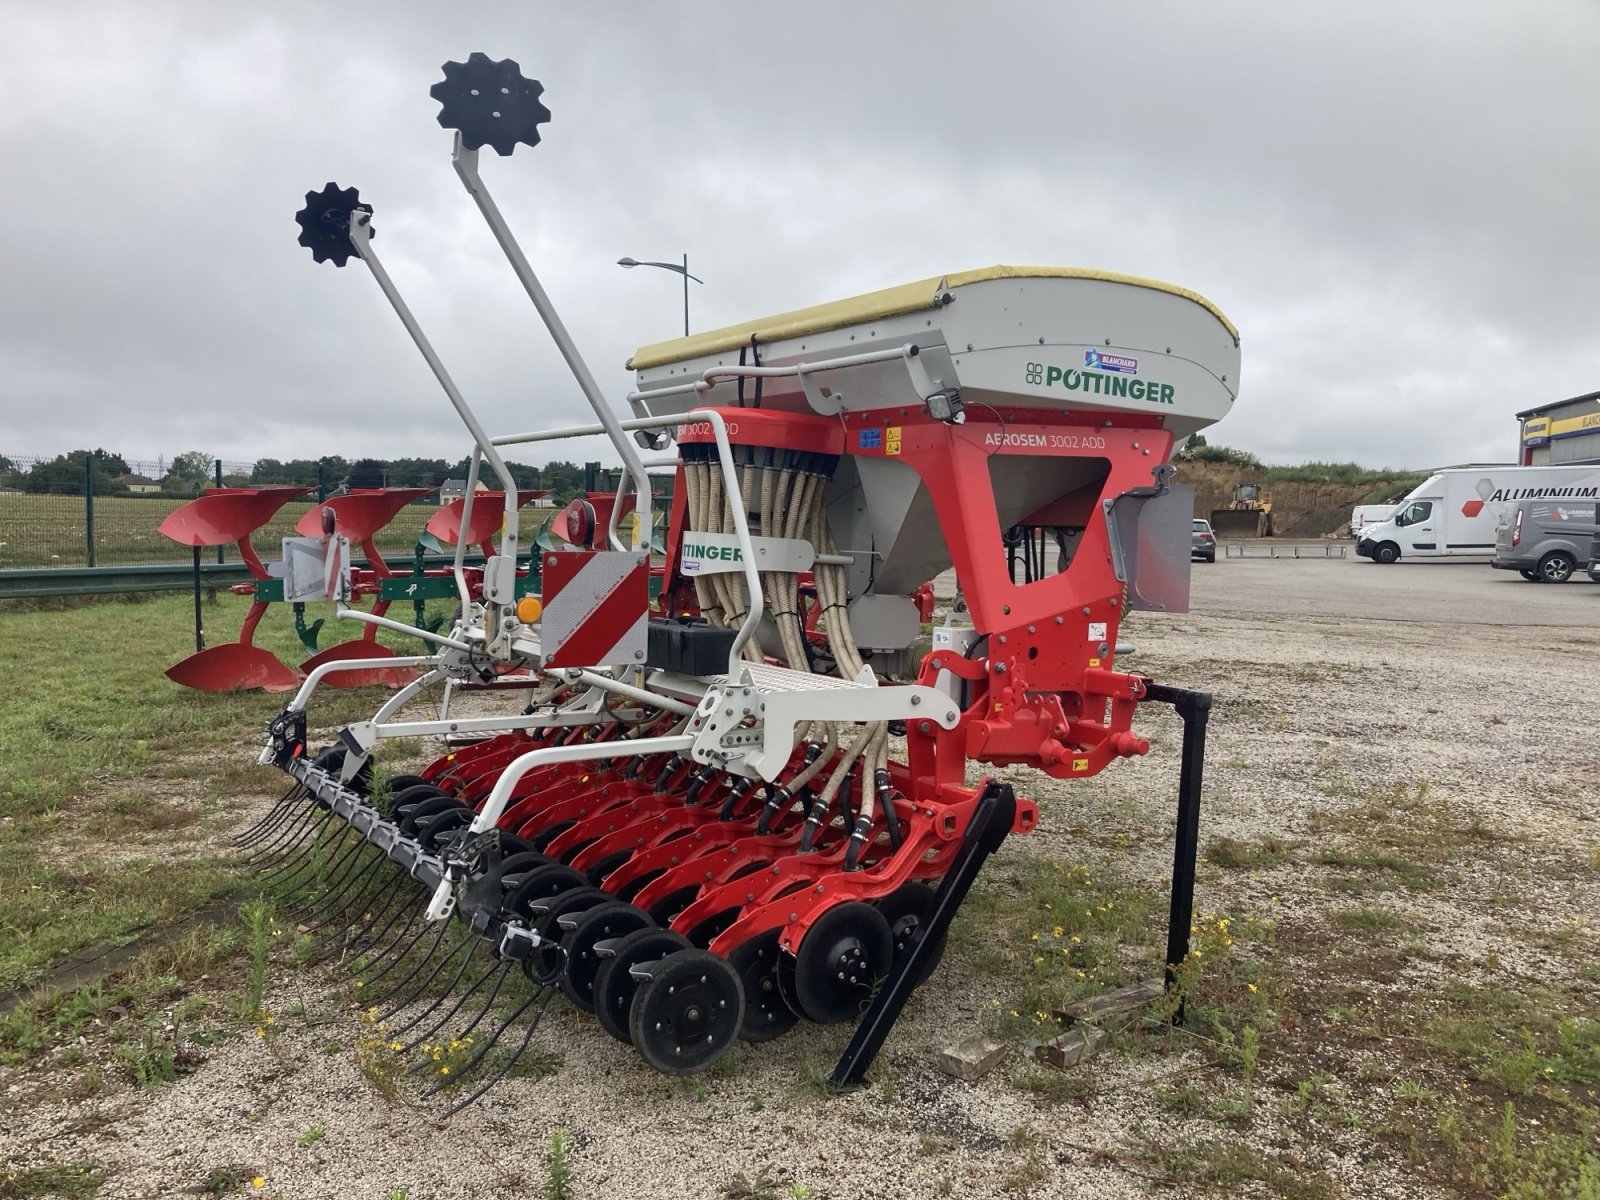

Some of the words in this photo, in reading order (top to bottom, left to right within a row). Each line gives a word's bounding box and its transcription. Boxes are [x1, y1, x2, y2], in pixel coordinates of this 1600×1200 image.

[1102, 355, 1136, 368] BLANCHARD
[1046, 366, 1175, 404] PÖTTINGER
[687, 423, 710, 435] 3002
[985, 433, 1047, 447] AEROSEM
[1049, 435, 1080, 448] 3002
[1081, 437, 1106, 449] ADD
[1489, 487, 1598, 502] ALUMINIUM
